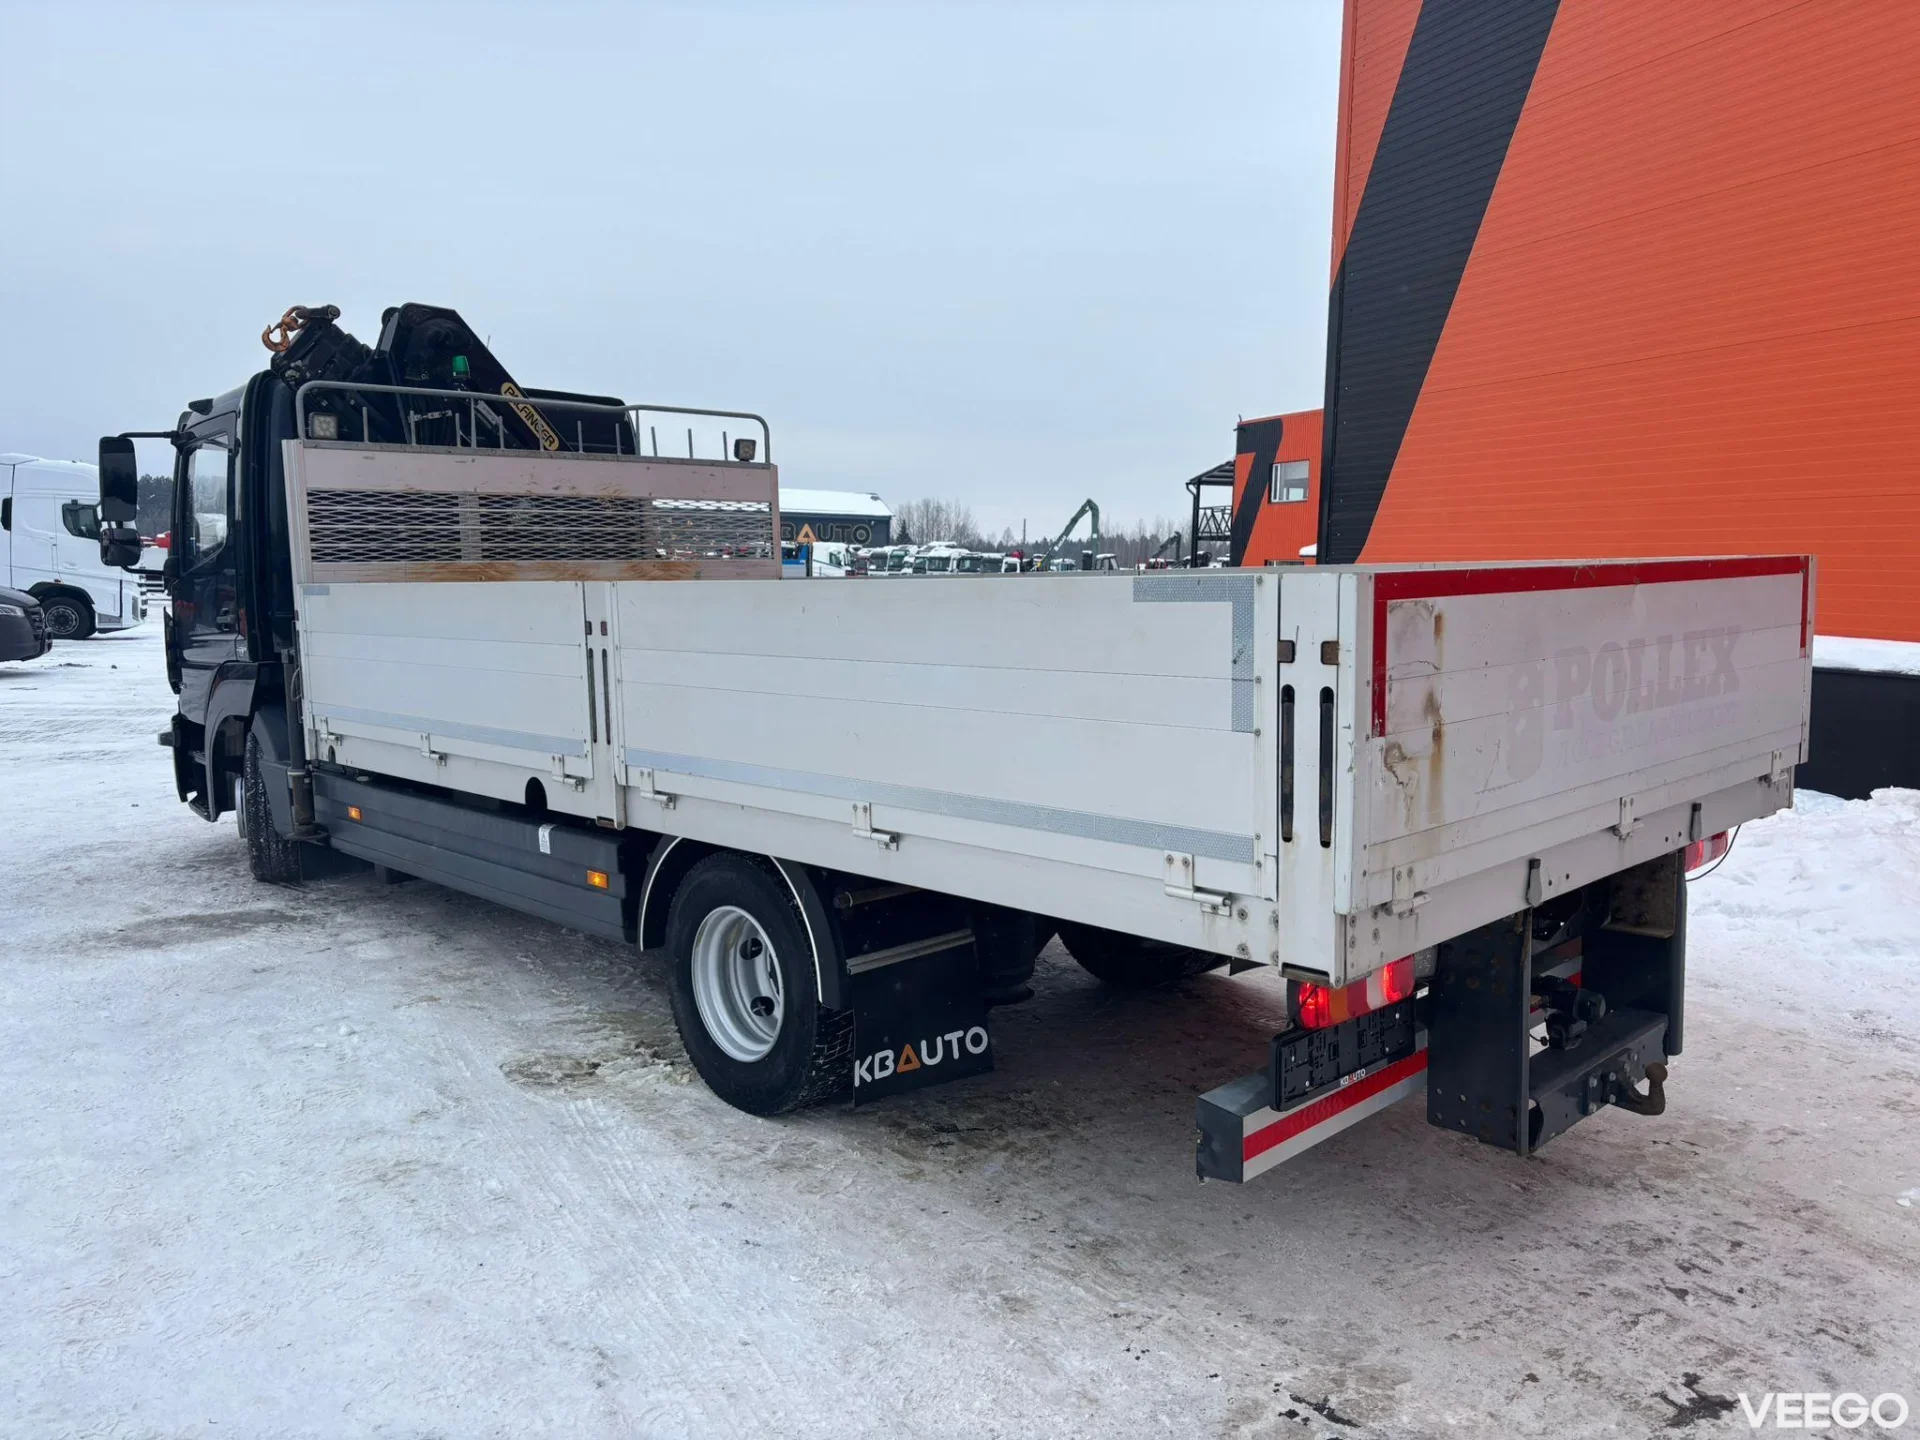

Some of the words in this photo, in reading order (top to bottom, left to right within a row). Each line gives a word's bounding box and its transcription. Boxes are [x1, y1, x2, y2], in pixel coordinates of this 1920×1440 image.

[780, 522, 872, 545] BAUTO
[1553, 625, 1741, 731] POLLEX
[854, 1026, 989, 1087] KBAUTO
